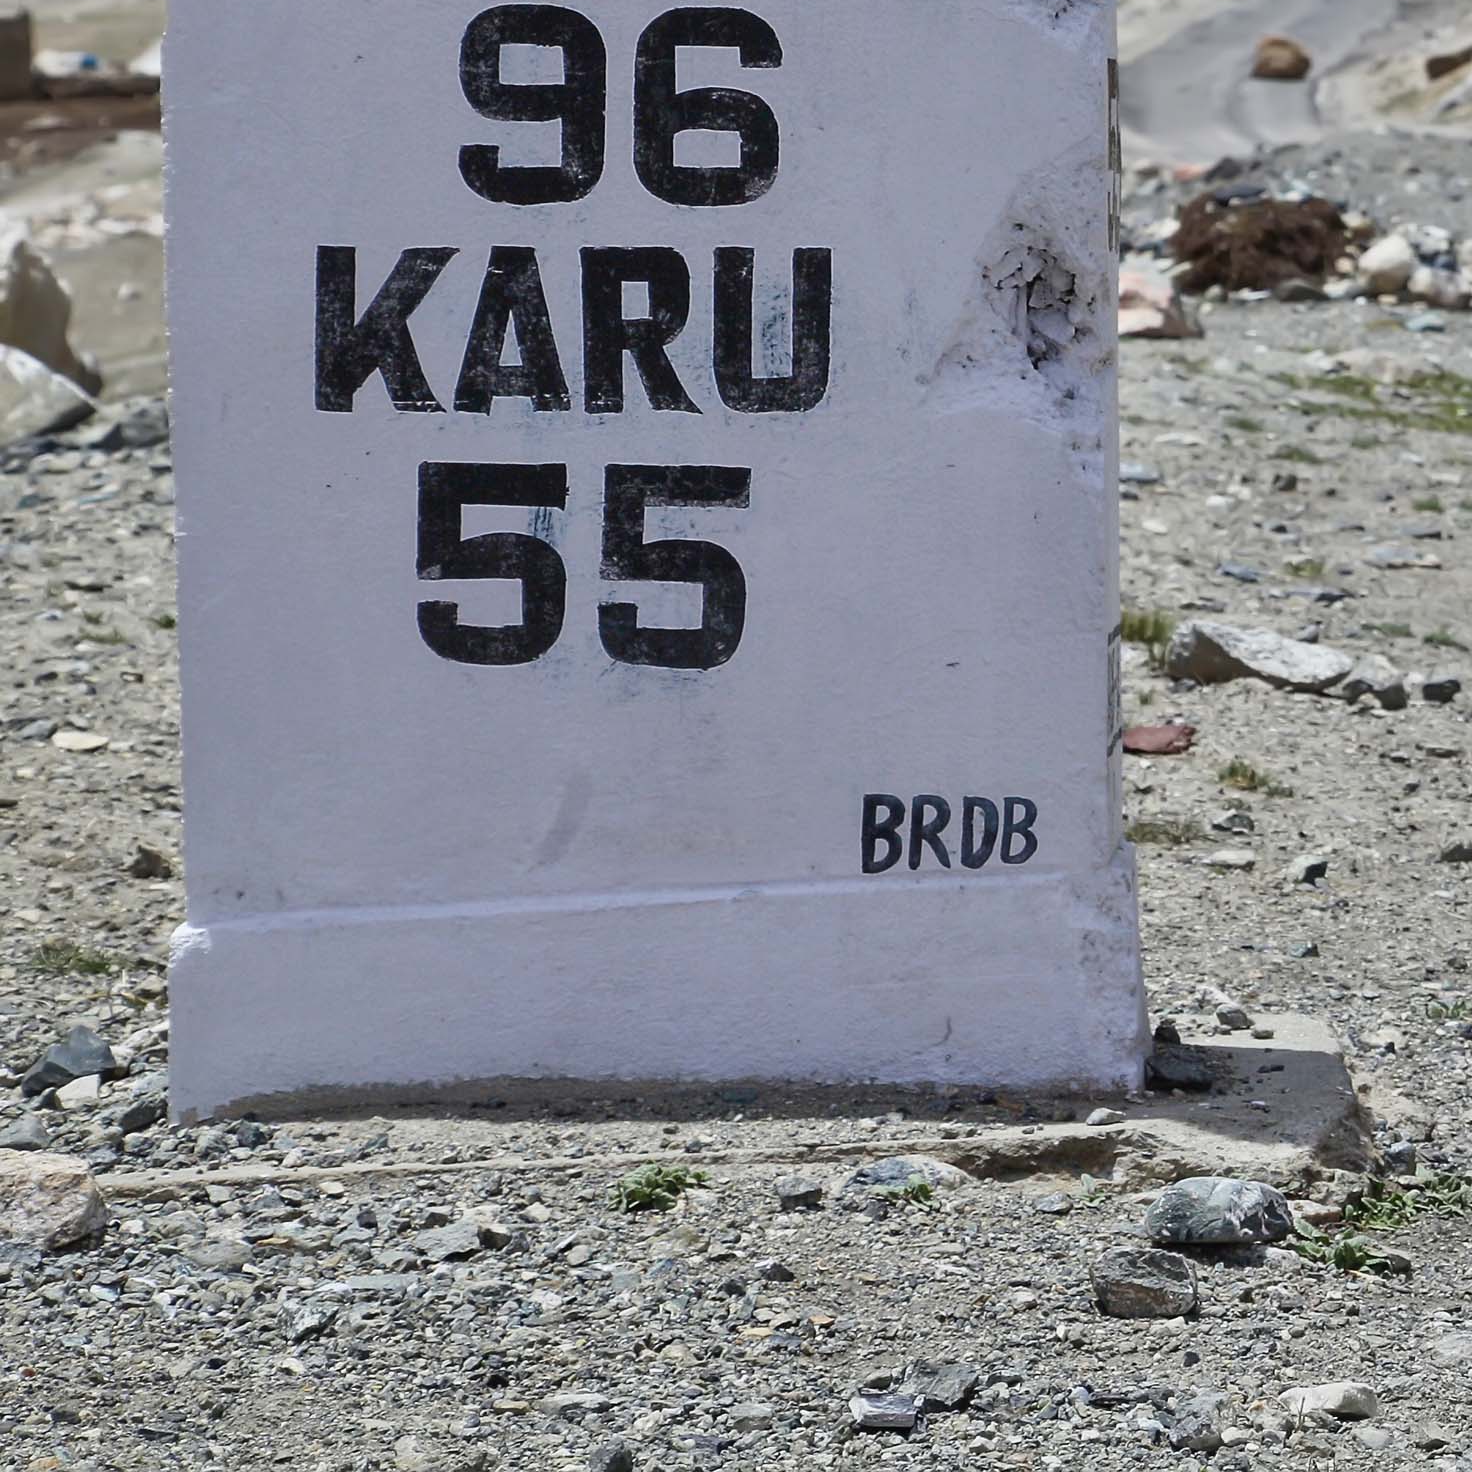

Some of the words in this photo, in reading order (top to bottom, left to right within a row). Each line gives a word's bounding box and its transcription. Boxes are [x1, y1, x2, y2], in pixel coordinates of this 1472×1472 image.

[458, 3, 783, 208] 96
[314, 245, 833, 417] KARU
[415, 460, 752, 672] 55
[860, 793, 1039, 875] BRDB
